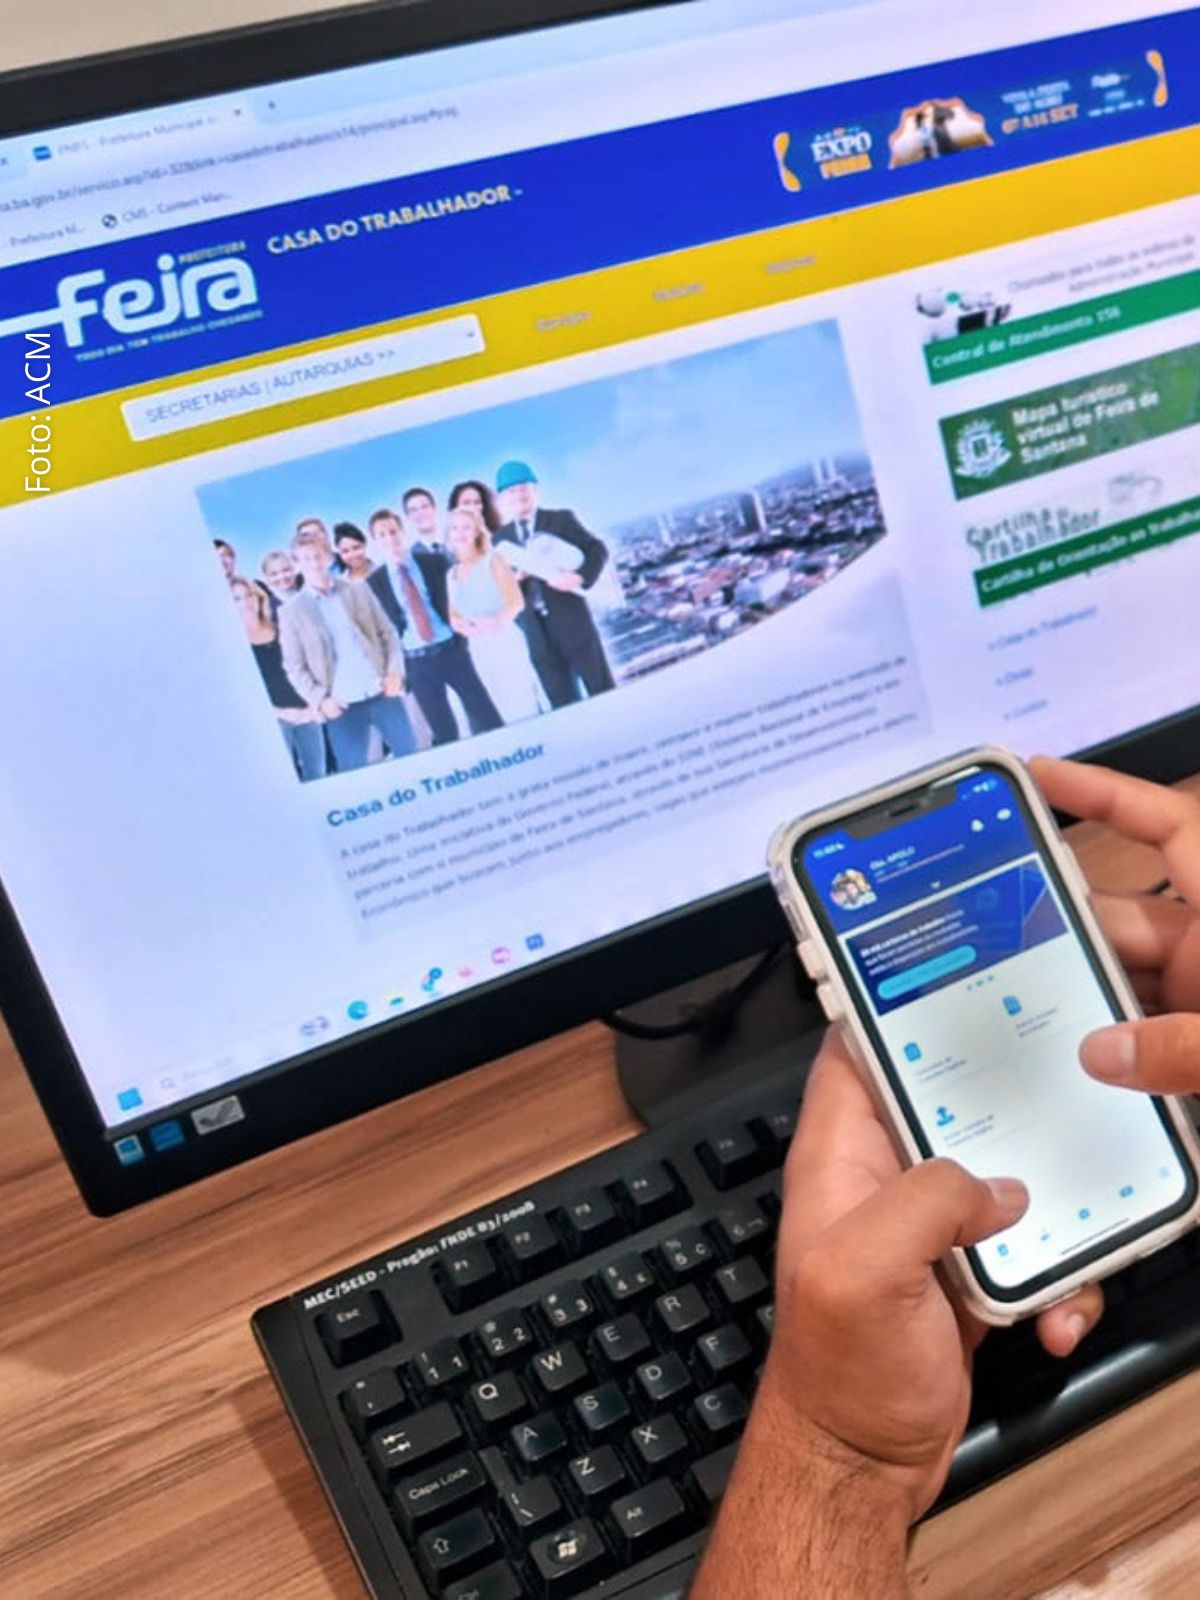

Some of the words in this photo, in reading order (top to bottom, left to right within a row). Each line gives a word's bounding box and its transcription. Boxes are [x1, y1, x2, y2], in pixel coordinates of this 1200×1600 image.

[811, 132, 871, 163] EXPO
[266, 228, 323, 255] CASA
[325, 219, 358, 241] DO
[359, 186, 511, 232] TRABALHADOR
[57, 254, 259, 348] feira
[931, 345, 984, 369] Central
[146, 384, 261, 421] SECRETARIAS
[272, 354, 373, 388] AUTARQUIAS
[1011, 401, 1058, 428] Mapa
[1016, 417, 1069, 445] virtual
[1071, 408, 1093, 428] de
[1094, 397, 1136, 420] Feira
[1137, 388, 1159, 409] de
[1019, 431, 1087, 464] Santana
[979, 566, 1035, 593] Cartilha
[1036, 558, 1055, 574] de
[1129, 529, 1146, 541] ao
[326, 797, 383, 828] Casa
[388, 785, 416, 806] do
[420, 742, 545, 794] Trabalhador
[303, 1269, 377, 1310] MEC/SEED
[440, 1226, 476, 1249] FNDE
[453, 1260, 469, 1272] F1
[723, 1267, 737, 1282] T
[663, 1295, 682, 1313] R
[336, 1308, 360, 1323] Esc
[602, 1325, 621, 1343] E
[704, 1335, 720, 1351] F
[540, 1352, 564, 1374] W
[645, 1365, 663, 1381] D
[478, 1383, 498, 1400] Q
[582, 1395, 600, 1410] S
[703, 1394, 722, 1411] C
[522, 1426, 539, 1443] A
[638, 1426, 660, 1444] X
[576, 1456, 596, 1476] Z
[408, 1480, 440, 1500] Caps
[440, 1467, 469, 1487] Lock
[626, 1506, 643, 1521] Alt
